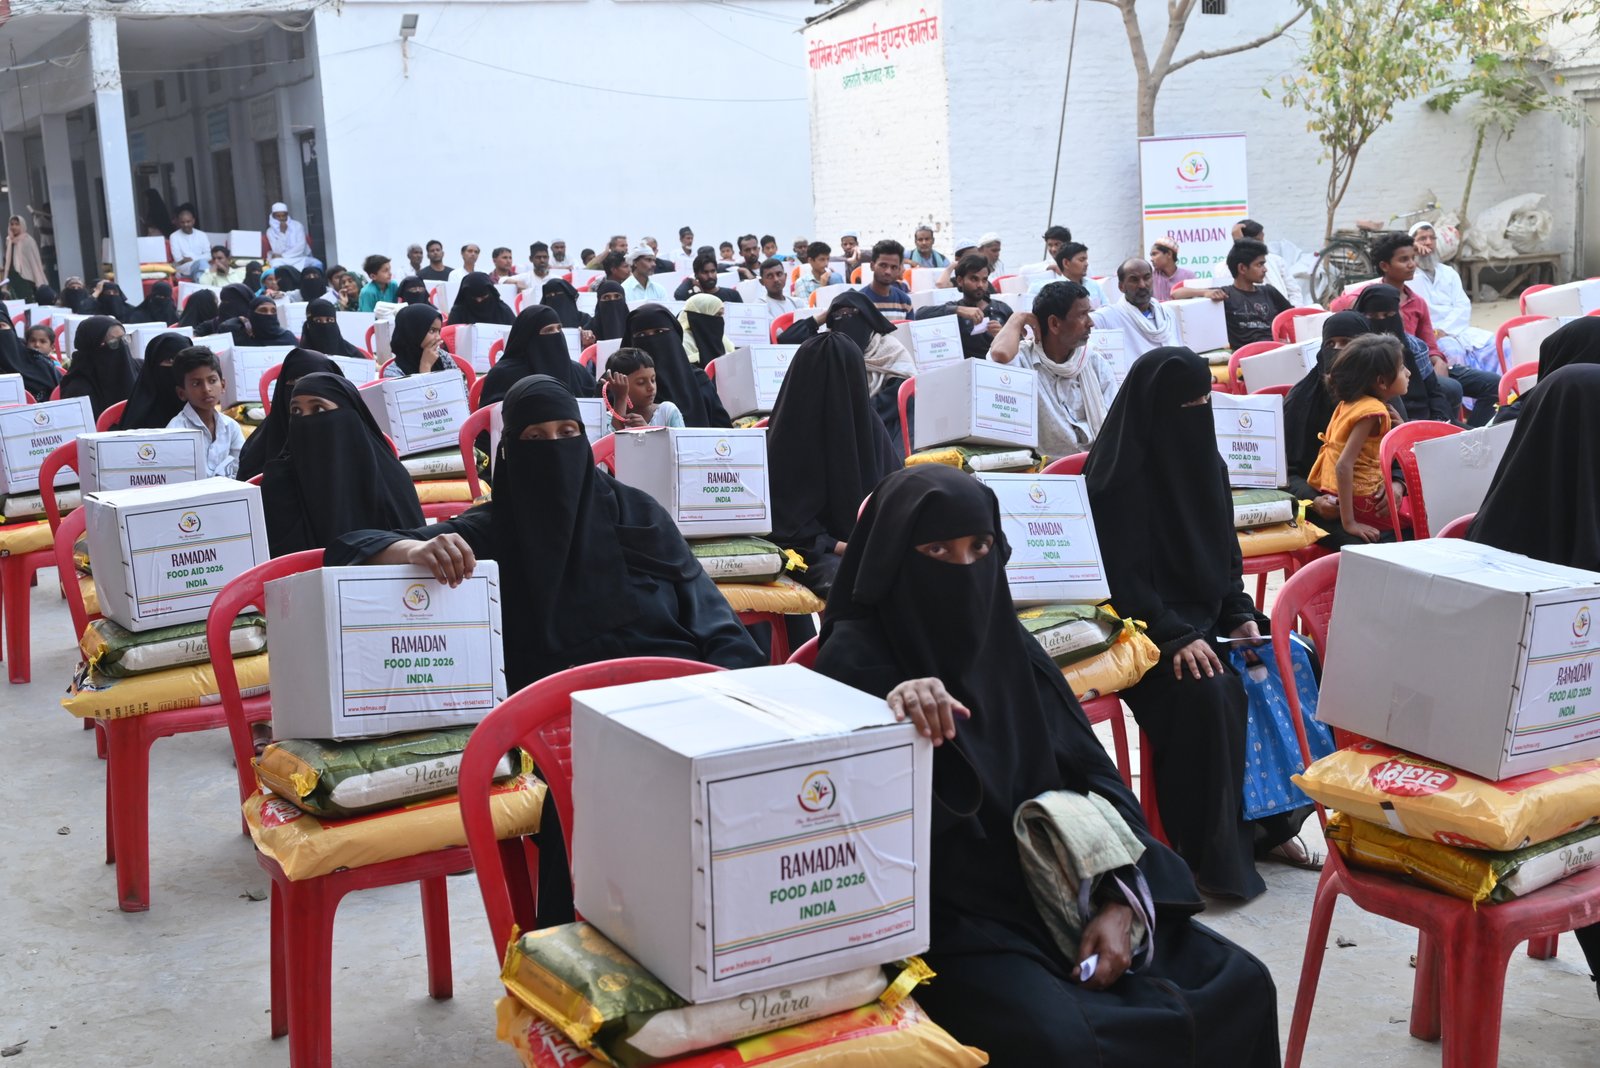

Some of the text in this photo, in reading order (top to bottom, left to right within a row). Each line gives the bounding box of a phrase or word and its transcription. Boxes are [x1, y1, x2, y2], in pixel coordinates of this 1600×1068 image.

[1167, 228, 1226, 243] RAMADAN
[1191, 256, 1209, 265] AID
[1195, 271, 1213, 279] DIA
[423, 408, 448, 420] RAMADAN
[31, 435, 62, 448] RAMADAN
[1232, 441, 1258, 452] RAMADAN
[29, 448, 44, 456] FOOD
[130, 474, 166, 486] RAMADAN
[707, 472, 740, 484] RAMADAN
[1027, 522, 1064, 536] RAMADAN
[1027, 539, 1045, 547] FOOD
[1046, 539, 1056, 547] AID
[171, 548, 217, 567] RAMADAN
[1043, 551, 1060, 560] INDIA
[711, 558, 743, 570] Naira
[167, 565, 224, 579] FOOD AID 2026
[186, 578, 208, 588] INDIA
[391, 635, 446, 654] RAMADAN
[384, 658, 454, 669] FOOD AID 2026
[406, 674, 433, 684] INDIA
[1556, 662, 1593, 686] RAMADAN
[1548, 687, 1592, 703] FOOD AID 2026
[1558, 705, 1576, 718] INDIA
[406, 764, 458, 783] Naira
[780, 842, 856, 880] RAMADAN
[1560, 849, 1593, 866] Naira
[770, 872, 866, 904] FOOD AID 2026
[799, 900, 836, 920] INDIA
[739, 994, 813, 1023] Naira
